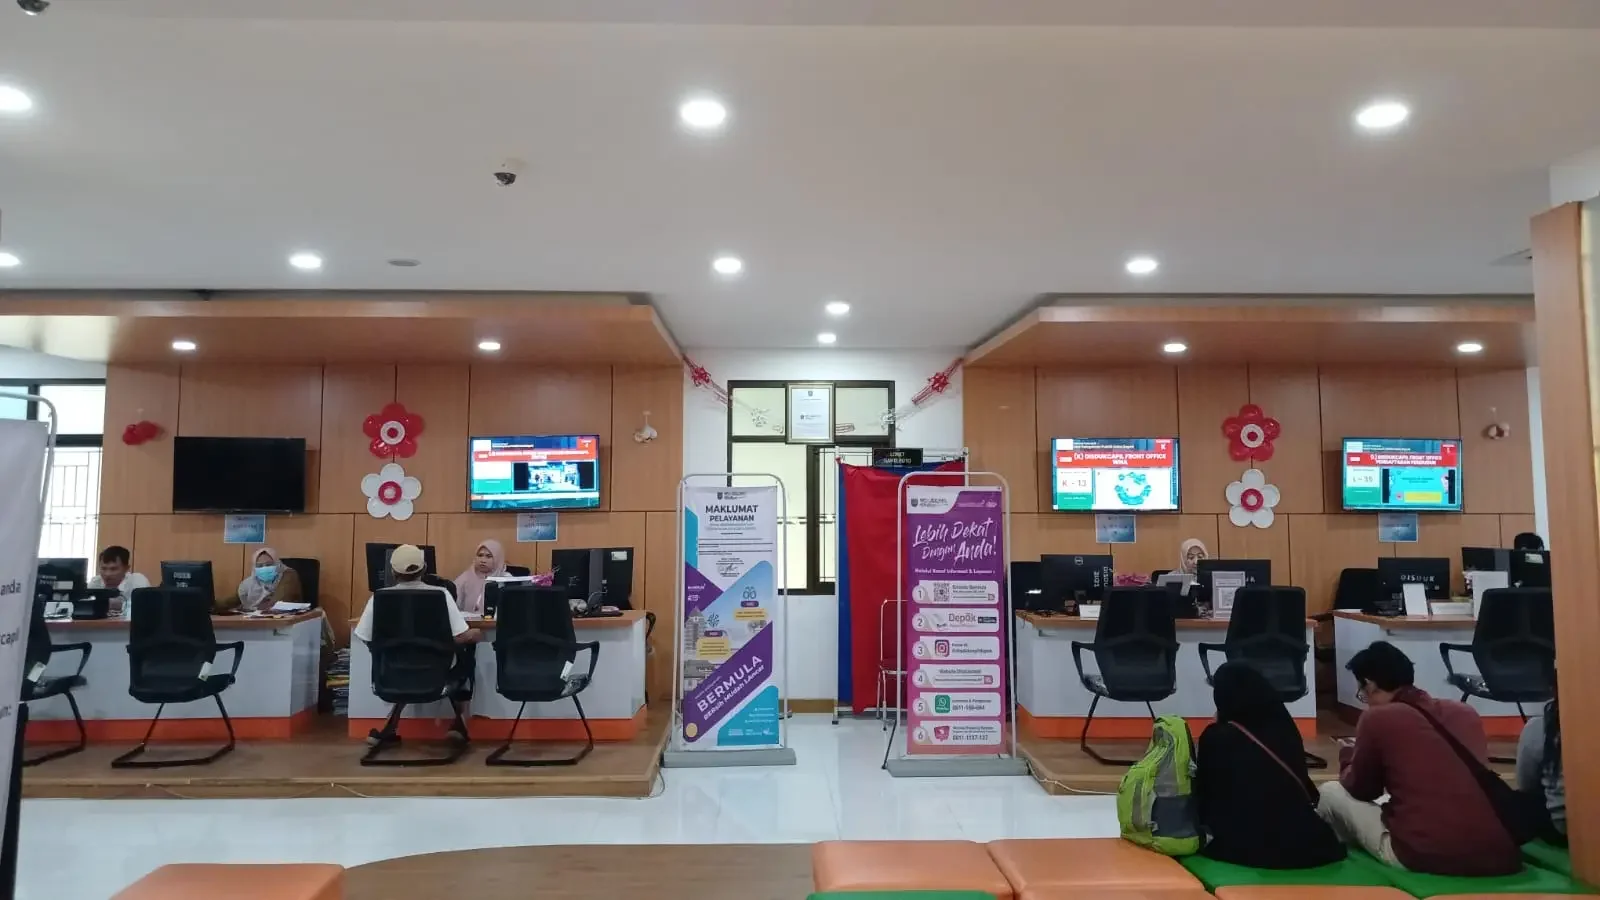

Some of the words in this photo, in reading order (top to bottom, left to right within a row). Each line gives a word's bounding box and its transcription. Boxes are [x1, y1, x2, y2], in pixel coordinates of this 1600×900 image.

[705, 504, 758, 513] MAKLUMAT
[913, 524, 948, 547] Lebih
[951, 517, 993, 539] Dekat
[697, 655, 763, 712] BERMULA
